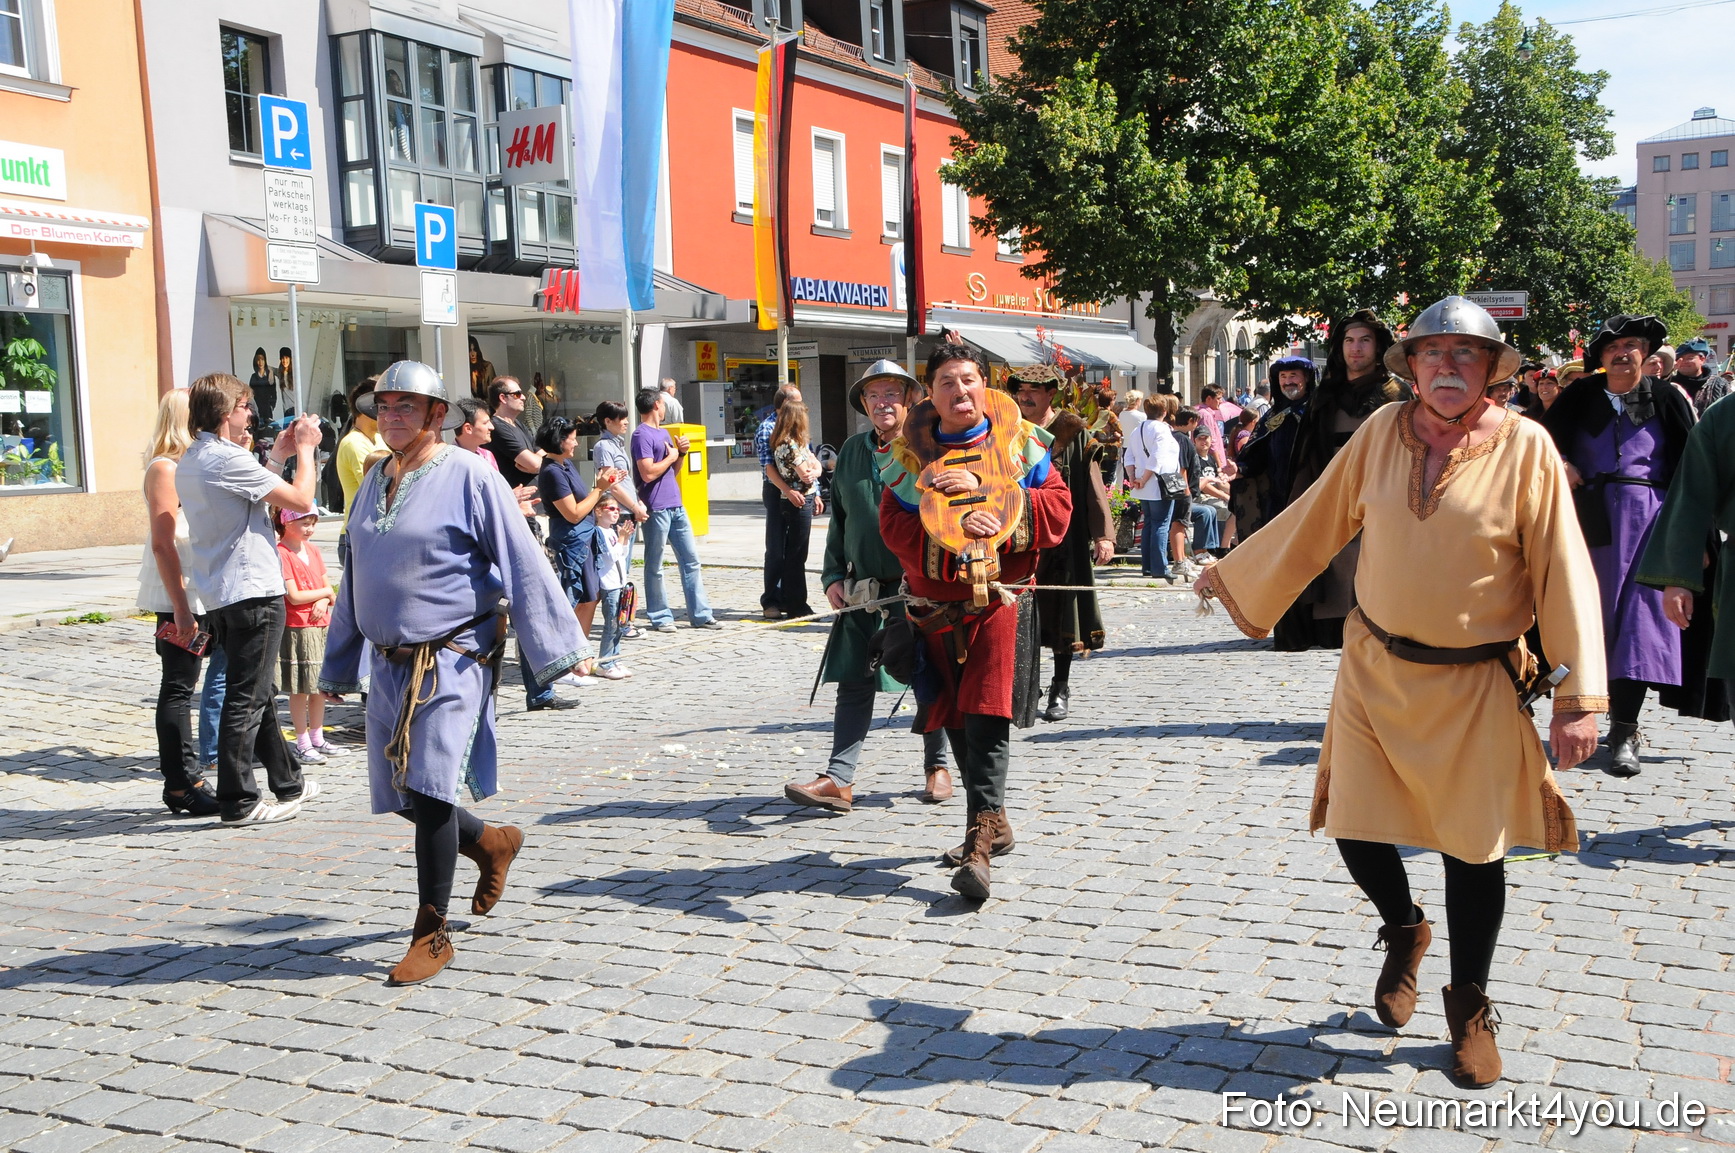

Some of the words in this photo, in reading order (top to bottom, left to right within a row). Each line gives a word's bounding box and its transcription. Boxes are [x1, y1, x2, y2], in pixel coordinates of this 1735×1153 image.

[271, 105, 299, 159] P
[505, 121, 556, 169] H&M
[274, 178, 288, 186] nur
[291, 179, 304, 189] mit
[268, 187, 311, 201] Parkschein
[272, 200, 309, 213] werktags
[11, 223, 38, 236] Der
[41, 226, 93, 242] Blumen
[270, 224, 279, 234] Sa
[424, 212, 447, 260] P
[542, 268, 580, 315] H&M
[790, 276, 889, 307] ABAKWAREN
[852, 348, 893, 358] NEUMARKTER
[698, 362, 716, 371] LOTTO
